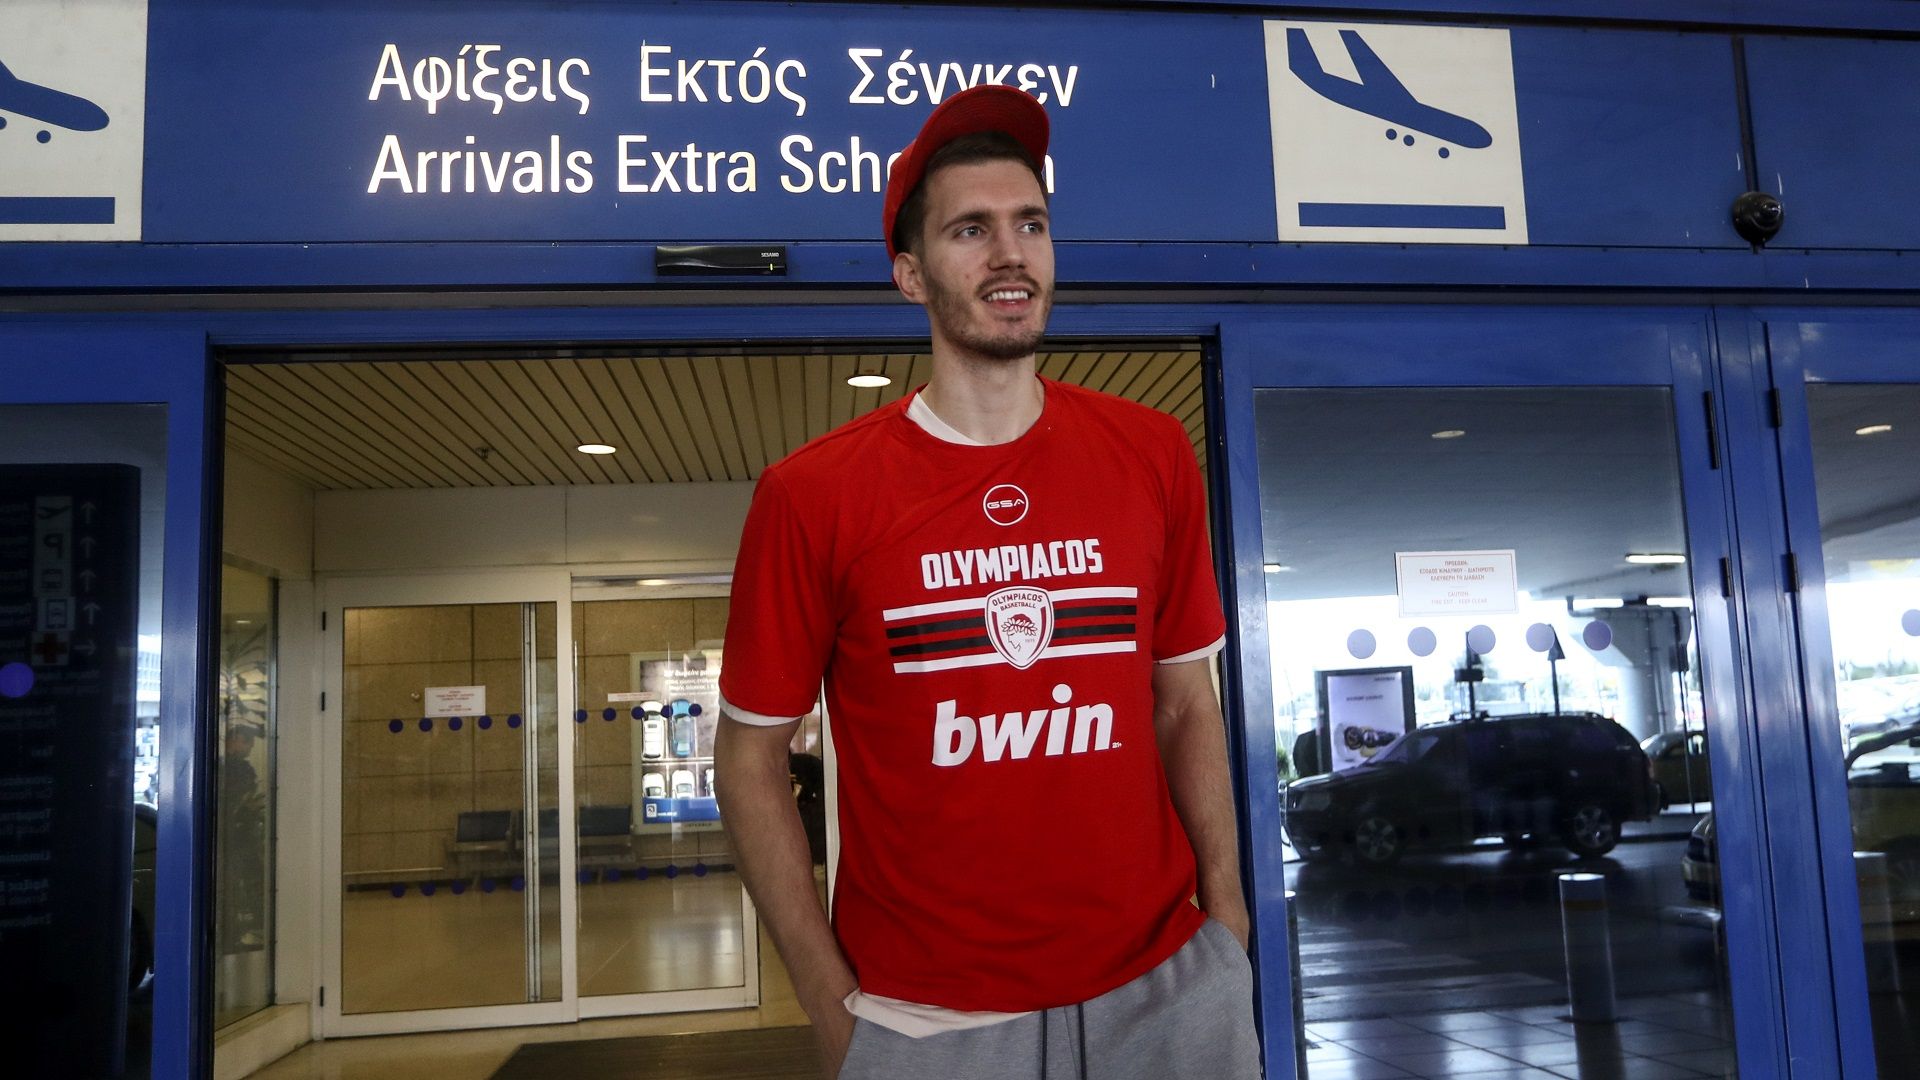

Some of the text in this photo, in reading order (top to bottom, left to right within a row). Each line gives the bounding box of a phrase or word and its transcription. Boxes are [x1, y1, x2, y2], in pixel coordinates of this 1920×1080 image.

[369, 44, 590, 115] Αφίξεις
[641, 45, 806, 117] Εκτός
[367, 134, 593, 193] Arrivals
[618, 134, 757, 193] Extra
[987, 498, 1025, 509] GSA
[921, 538, 1103, 590] OLYMPIACOS
[992, 593, 1043, 607] OLYMPIACOS
[1000, 602, 1036, 612] BASKETBALL
[931, 683, 1114, 767] bwin
